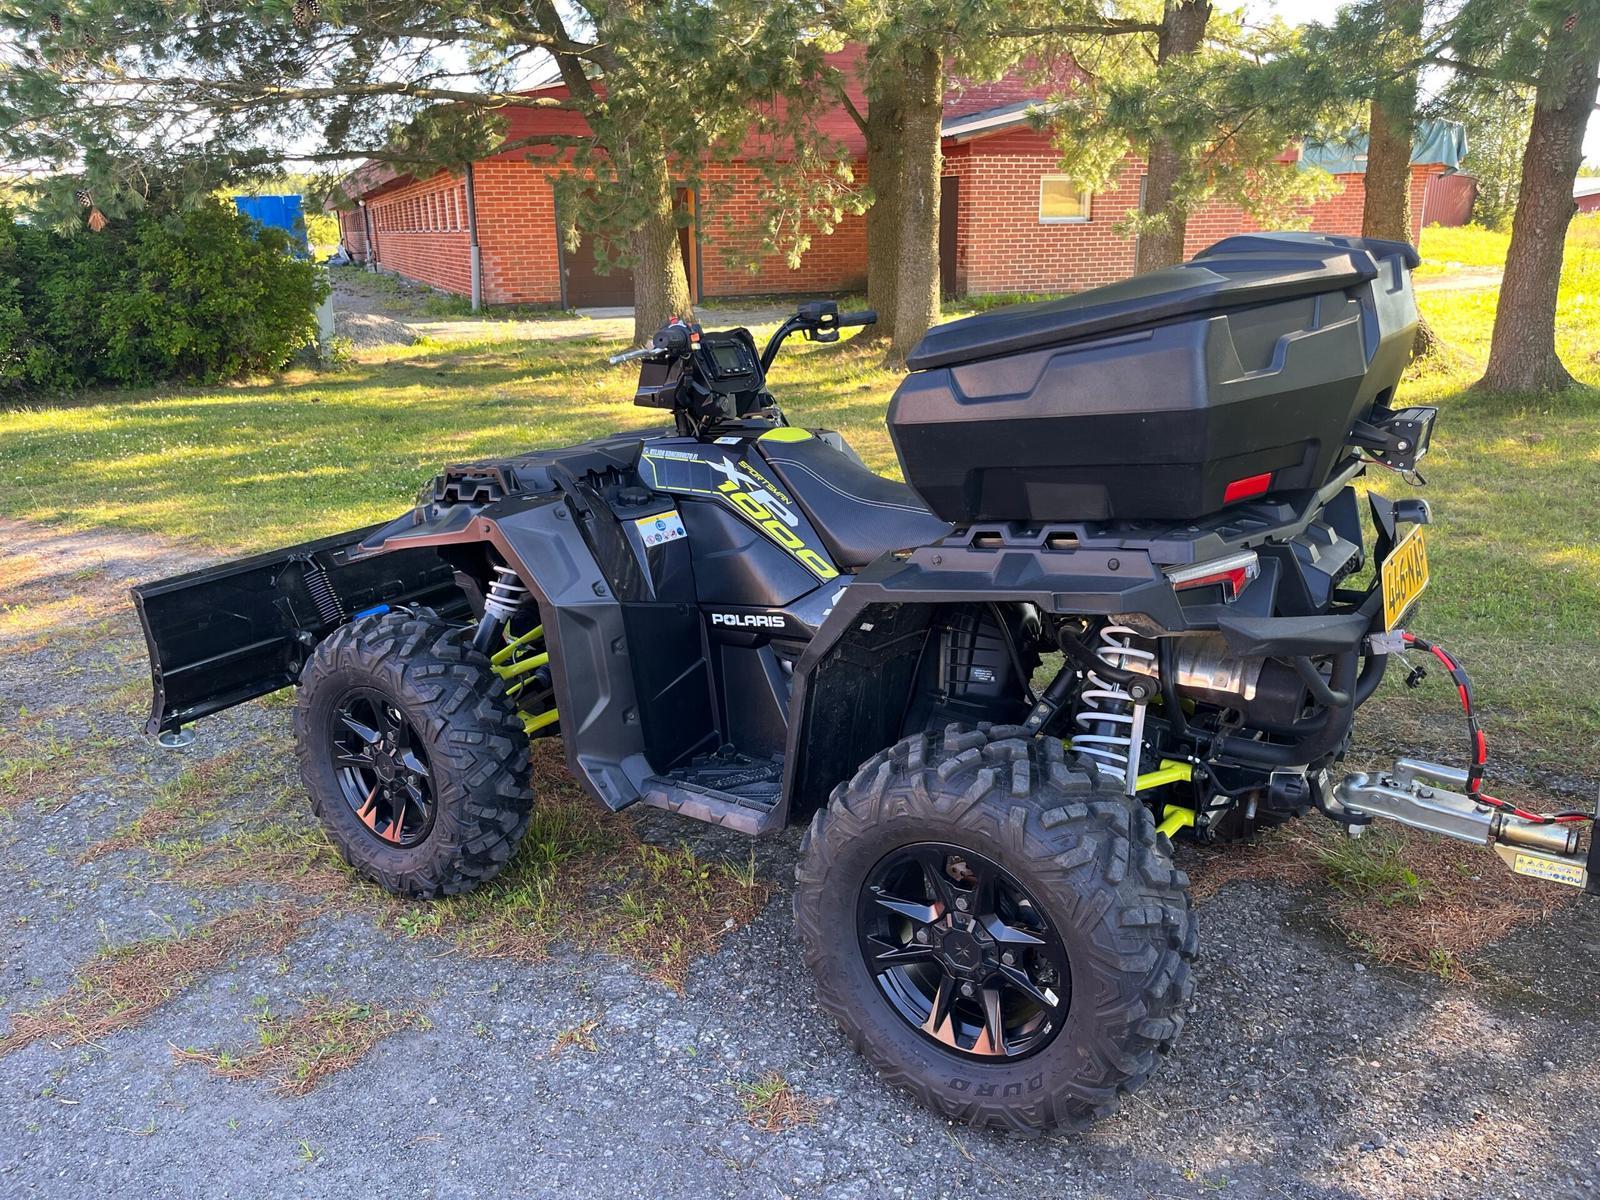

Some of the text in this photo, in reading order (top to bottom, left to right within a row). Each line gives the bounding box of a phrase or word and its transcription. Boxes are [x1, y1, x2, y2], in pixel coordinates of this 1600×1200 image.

[738, 460, 792, 504] SPORTSMAN
[717, 480, 839, 578] 1000
[711, 613, 786, 628] POLARIS
[948, 1072, 1044, 1098] DURO
